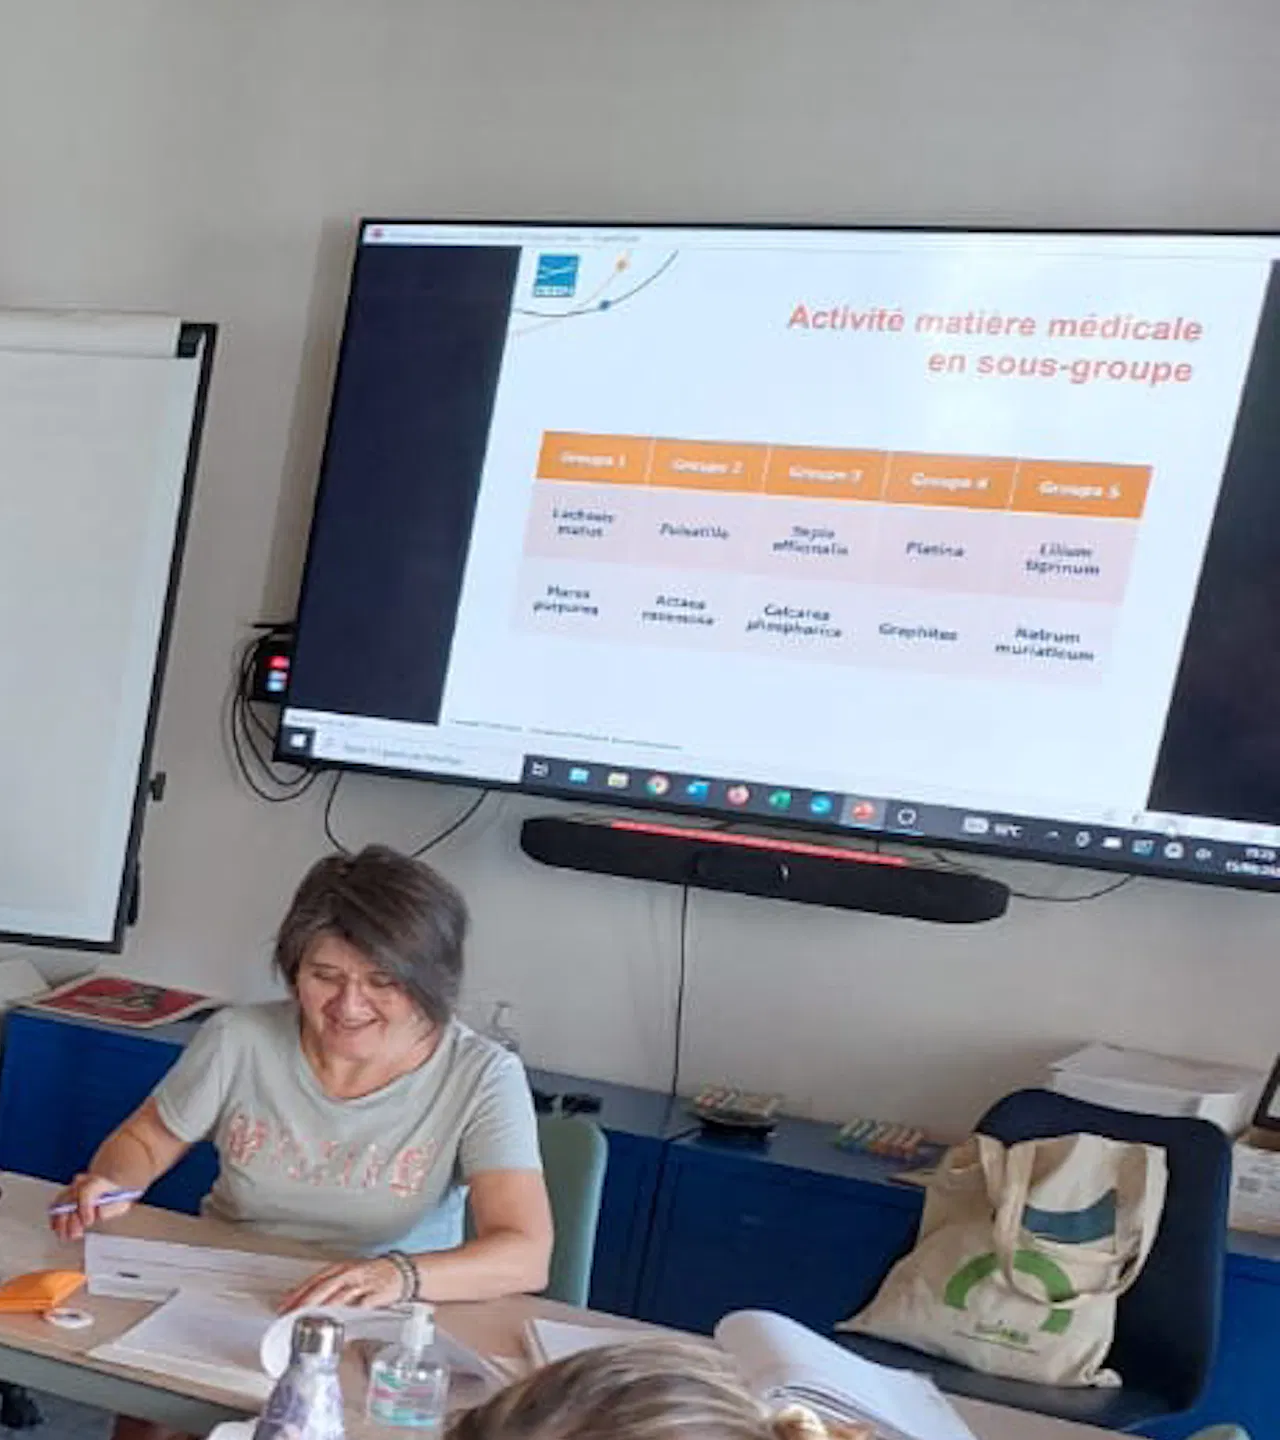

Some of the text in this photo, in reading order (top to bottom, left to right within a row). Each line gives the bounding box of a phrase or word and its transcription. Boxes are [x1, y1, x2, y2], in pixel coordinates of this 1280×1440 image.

[787, 304, 1204, 343] Activité matière médicale
[927, 351, 1193, 387] en sous-groupe
